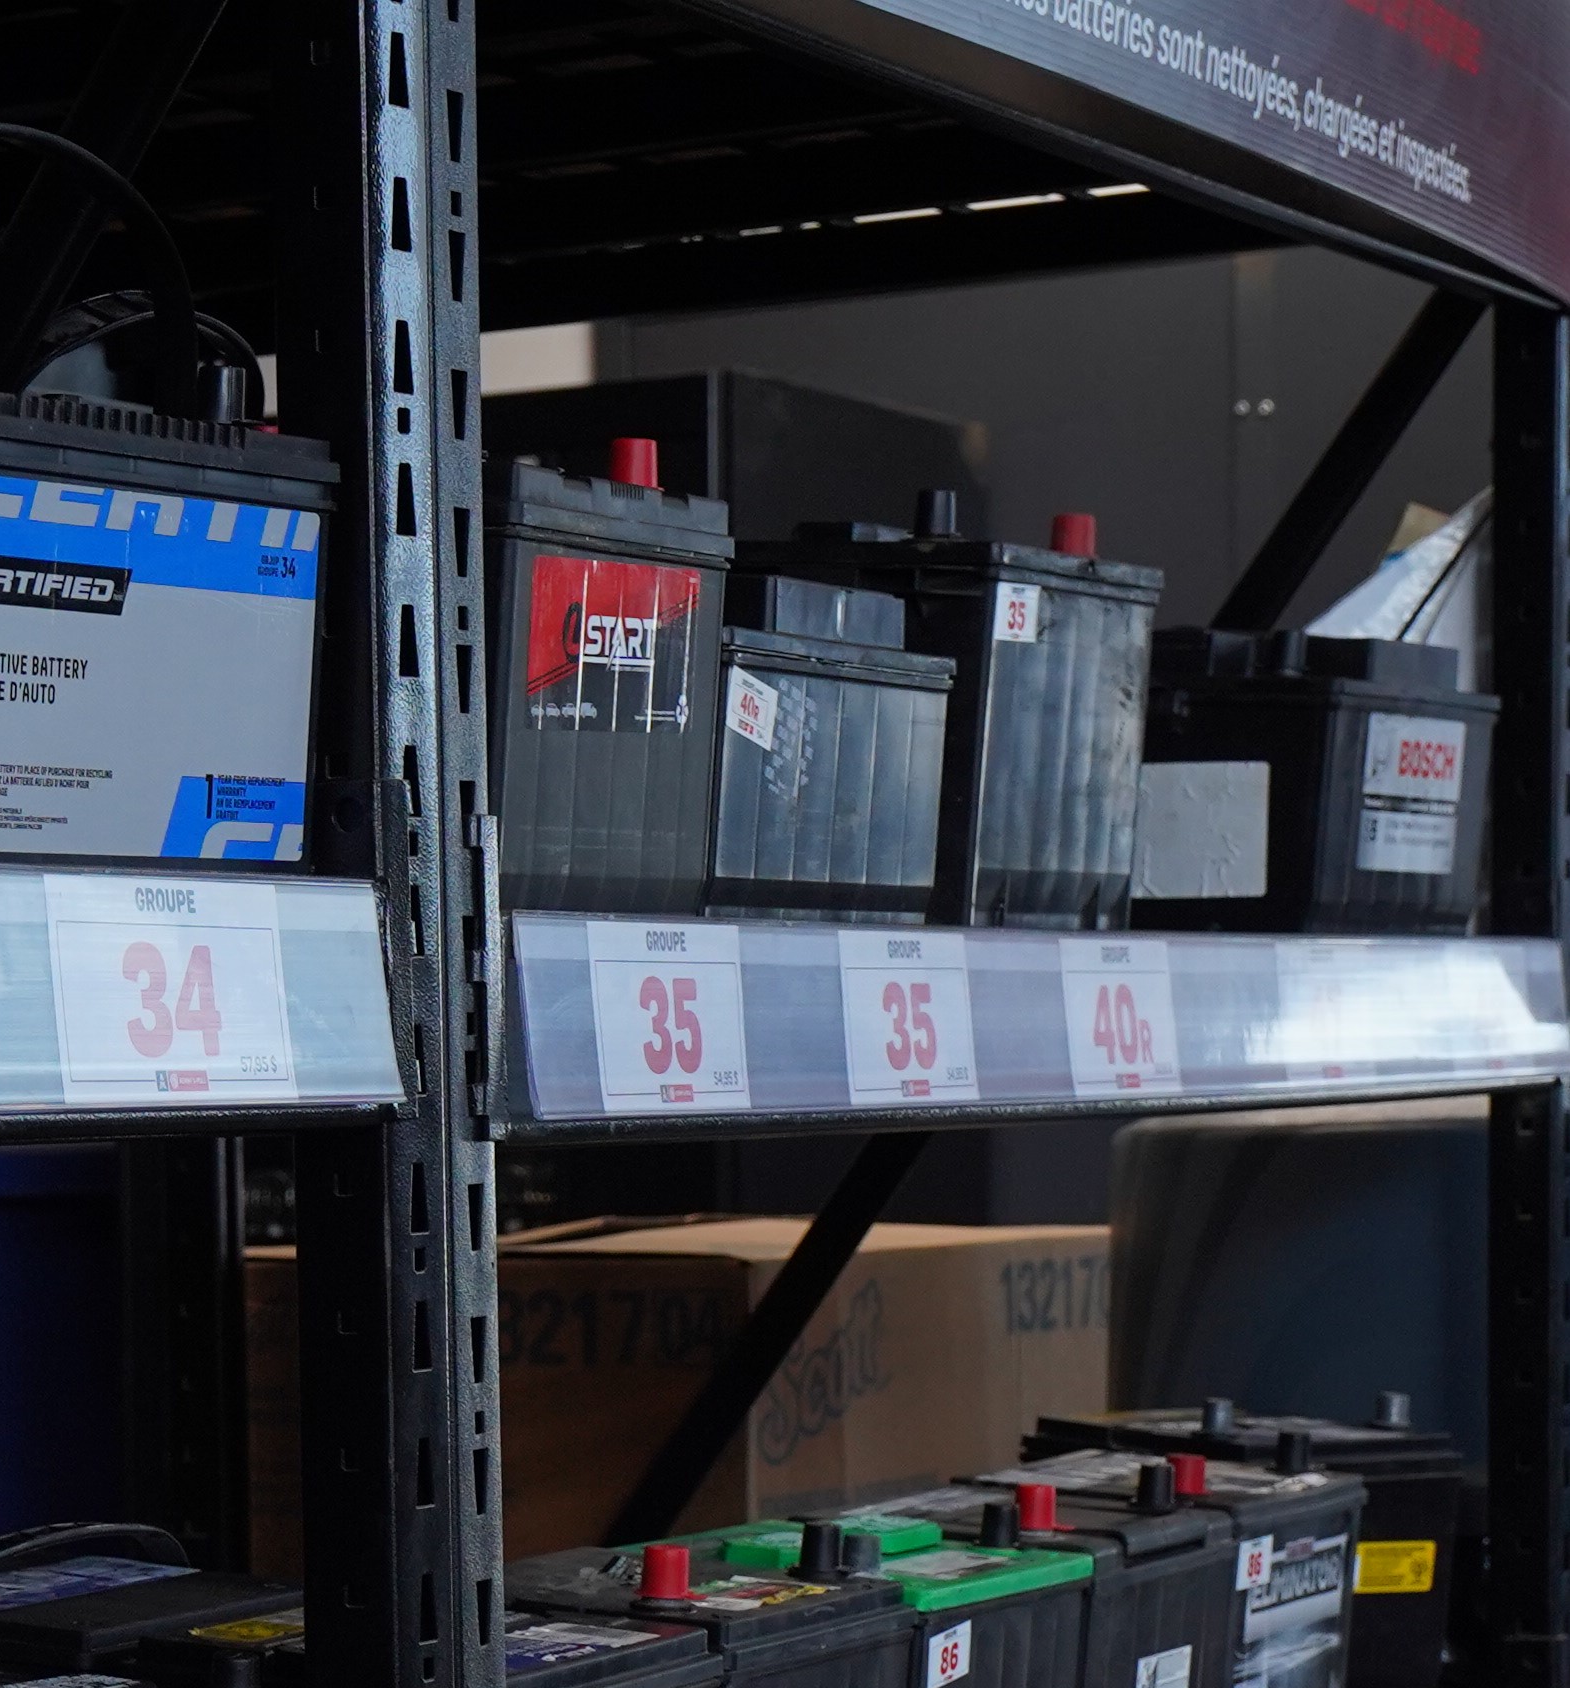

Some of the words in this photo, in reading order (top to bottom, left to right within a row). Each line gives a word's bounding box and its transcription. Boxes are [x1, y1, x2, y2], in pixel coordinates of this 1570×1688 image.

[1156, 25, 1203, 80] sont
[1205, 45, 1301, 131] nettoyées,
[1304, 77, 1379, 158] chargées
[1378, 120, 1397, 166] et
[1007, 602, 1025, 630] 35
[32, 656, 88, 679] BATTERY
[9, 683, 56, 704] D'AUTO
[1399, 740, 1454, 779] BOSCH
[135, 887, 196, 913] GROUPE
[646, 931, 686, 952] GROUPE
[887, 940, 922, 959] GROUPE
[122, 941, 222, 1058] 34
[639, 976, 702, 1074] 35
[883, 981, 937, 1070] 35
[1093, 983, 1155, 1064] 40R
[940, 1642, 958, 1675] 86
